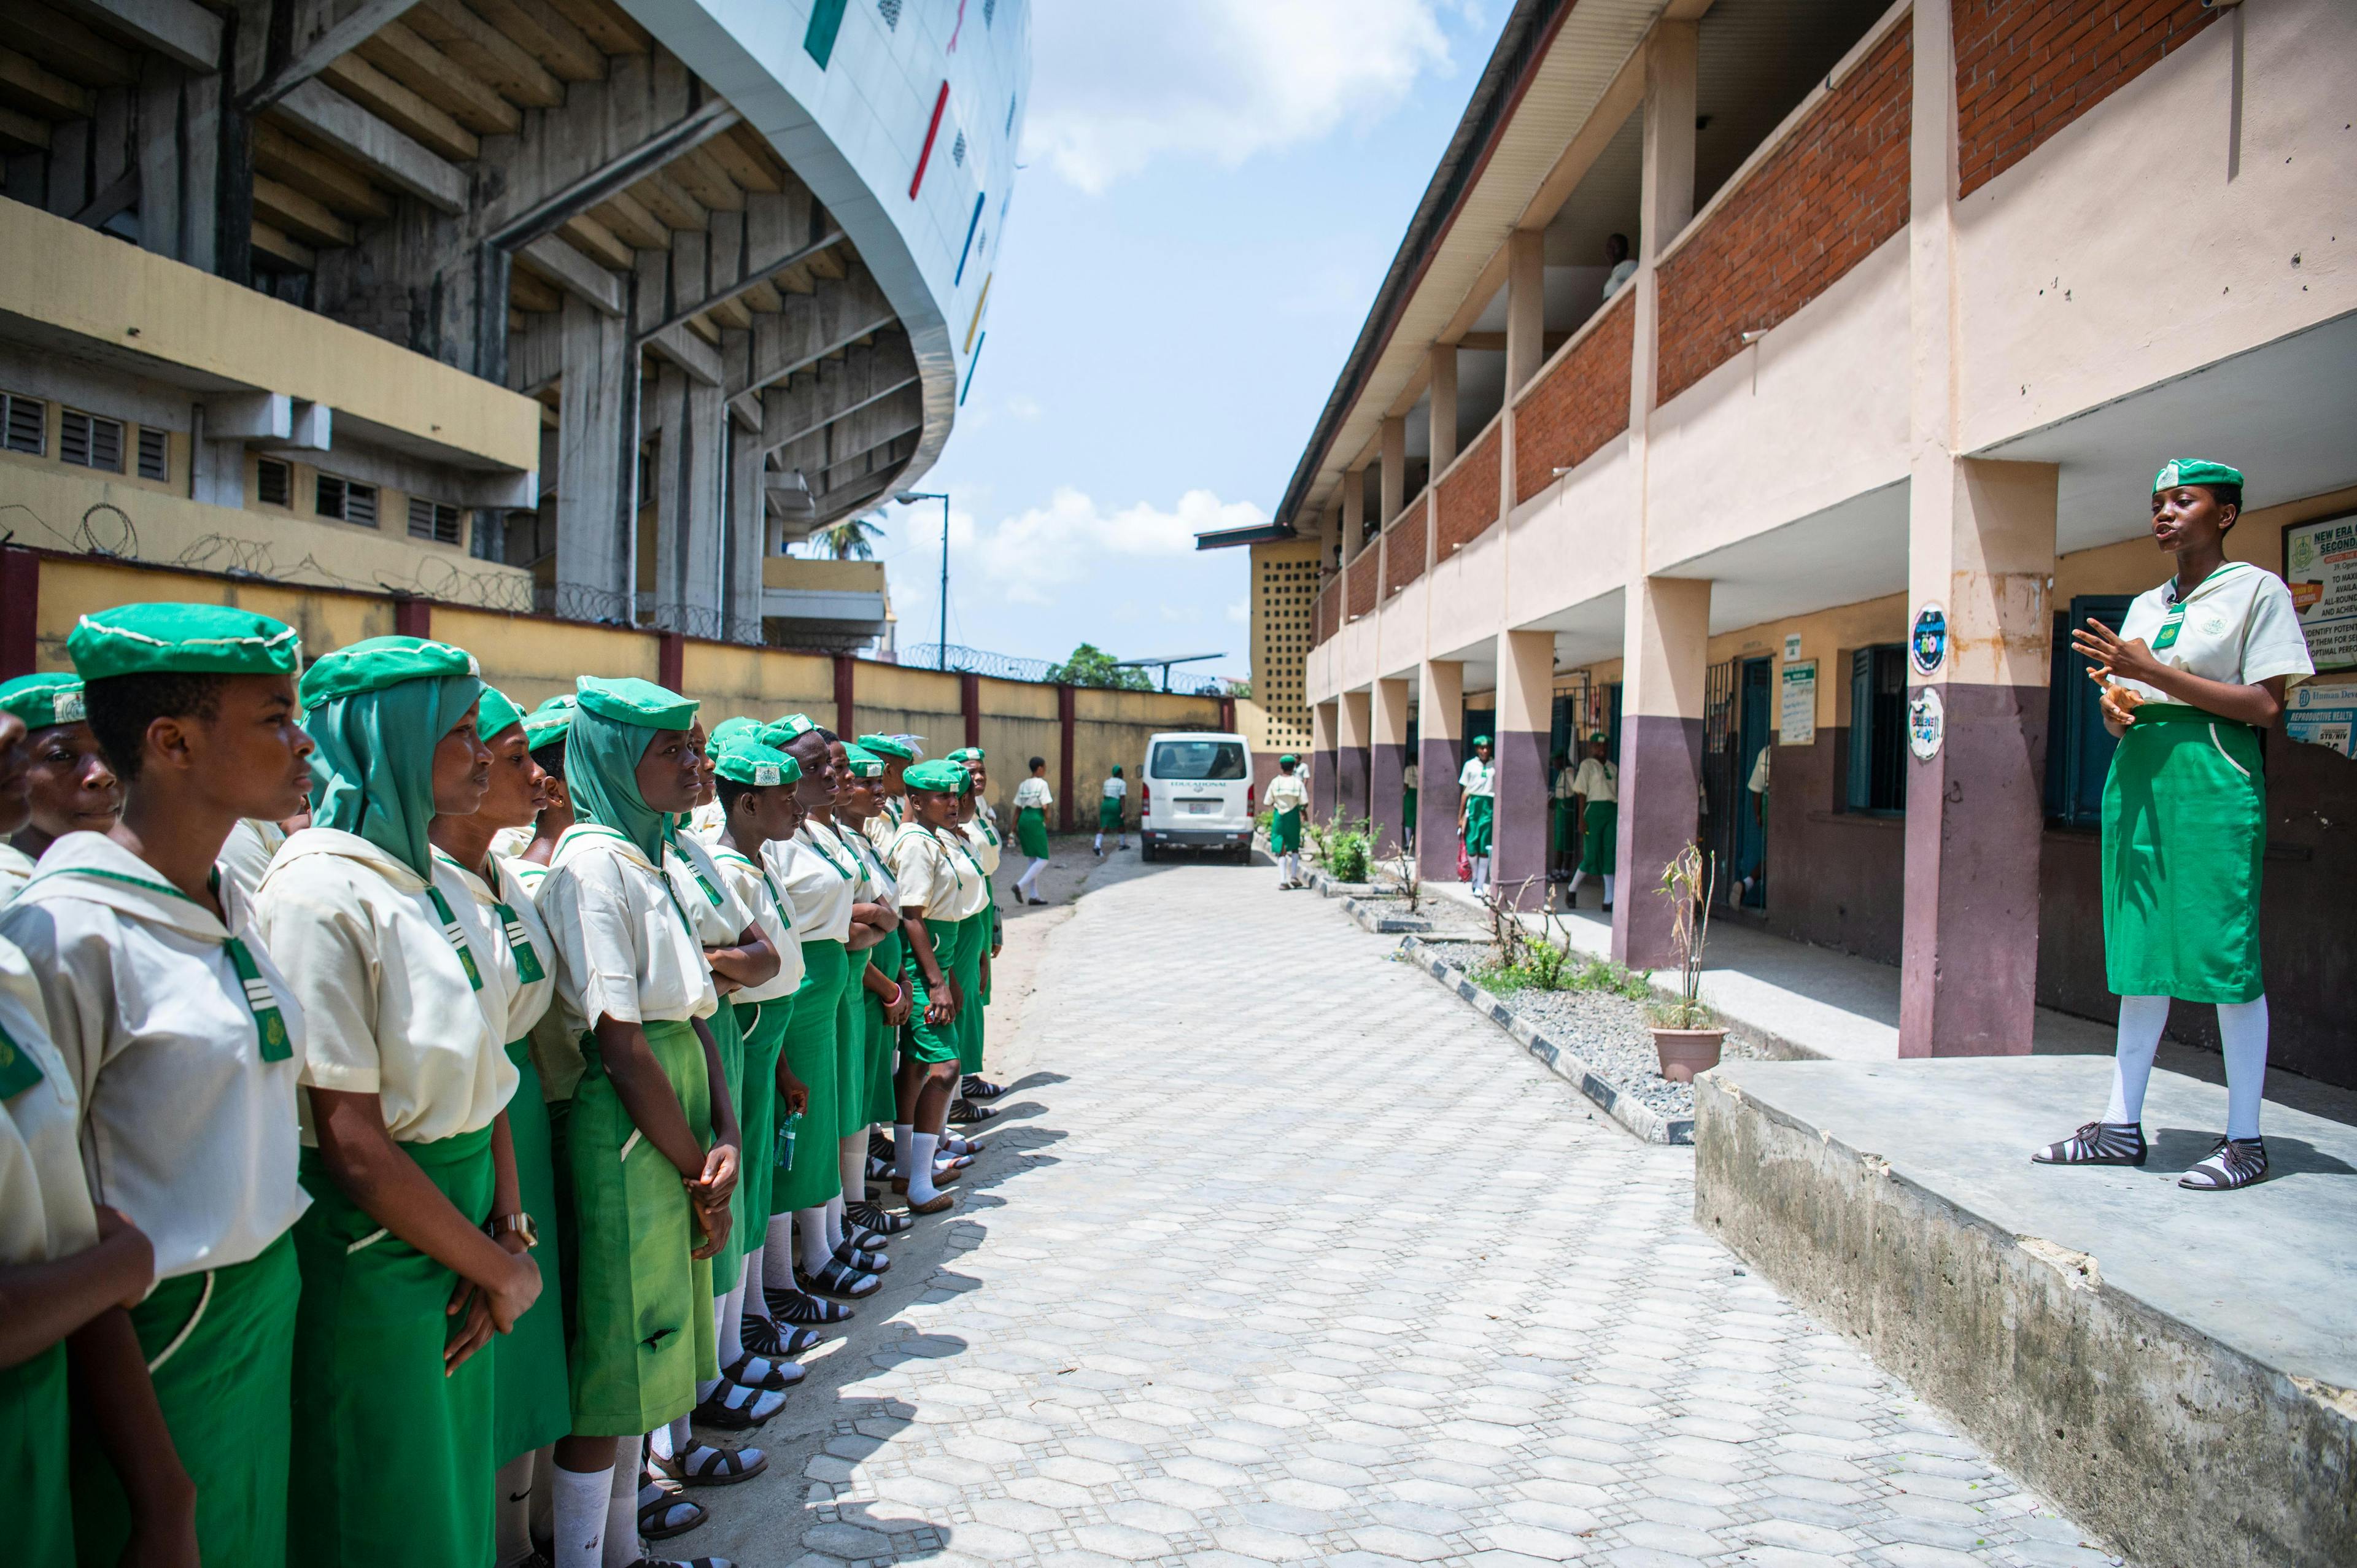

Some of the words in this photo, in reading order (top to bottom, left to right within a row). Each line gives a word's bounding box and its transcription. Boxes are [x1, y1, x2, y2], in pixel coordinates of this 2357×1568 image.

[2315, 529, 2333, 541] NEW
[2336, 525, 2352, 538] ERA
[2321, 537, 2357, 553] SECOND
[2342, 573, 2357, 582] MAXI
[2321, 608, 2334, 617] AND
[2305, 627, 2332, 637] IDENTIFY
[2316, 637, 2333, 646] THEM
[2311, 647, 2337, 657] OPTIMAL
[2339, 644, 2357, 654] PERFO
[2290, 712, 2331, 722] REPRODUCTIVE
[2332, 711, 2353, 720] HEALTH
